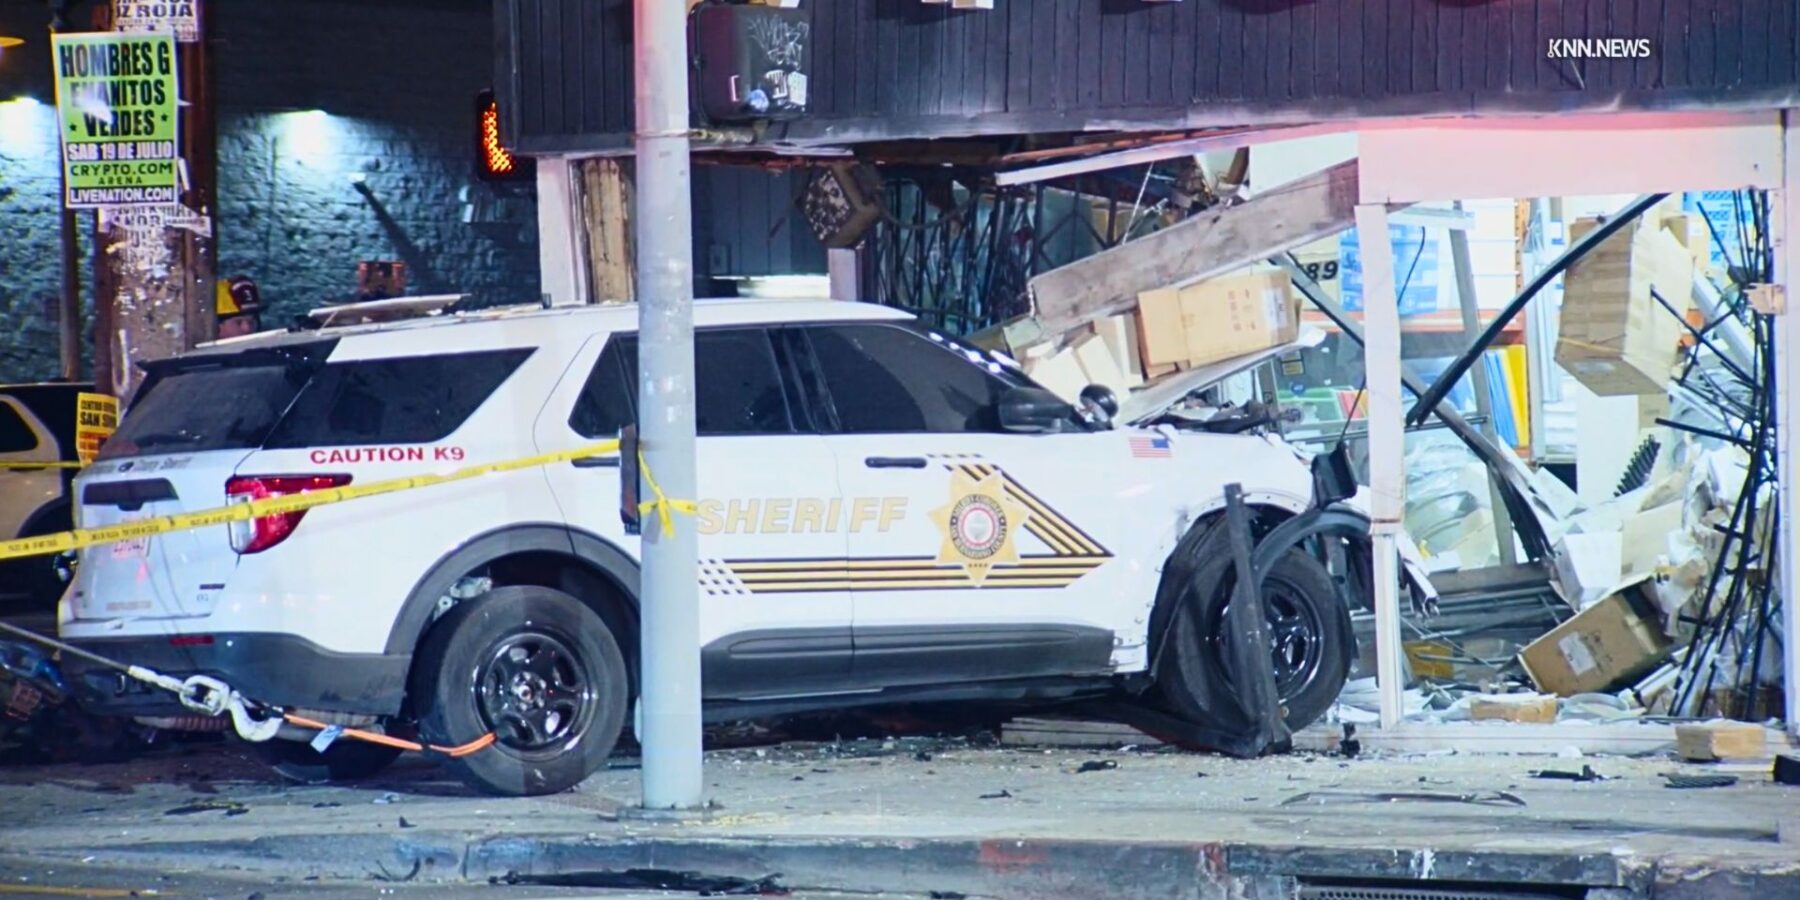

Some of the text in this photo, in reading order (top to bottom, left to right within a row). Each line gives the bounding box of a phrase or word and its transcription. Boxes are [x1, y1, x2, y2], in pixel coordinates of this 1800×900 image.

[137, 4, 193, 18] ROJA
[59, 41, 170, 77] HOMBRES G
[83, 110, 154, 136] VERDES
[68, 141, 172, 160] SAB 19 DE JULIO
[70, 163, 173, 176] CRYPTO.COM
[98, 176, 143, 185] ARENA
[71, 187, 173, 203] LIVENATION.COM
[80, 411, 100, 427] SAN
[310, 446, 465, 464] CAUTION K9
[696, 497, 909, 535] SHERIFF
